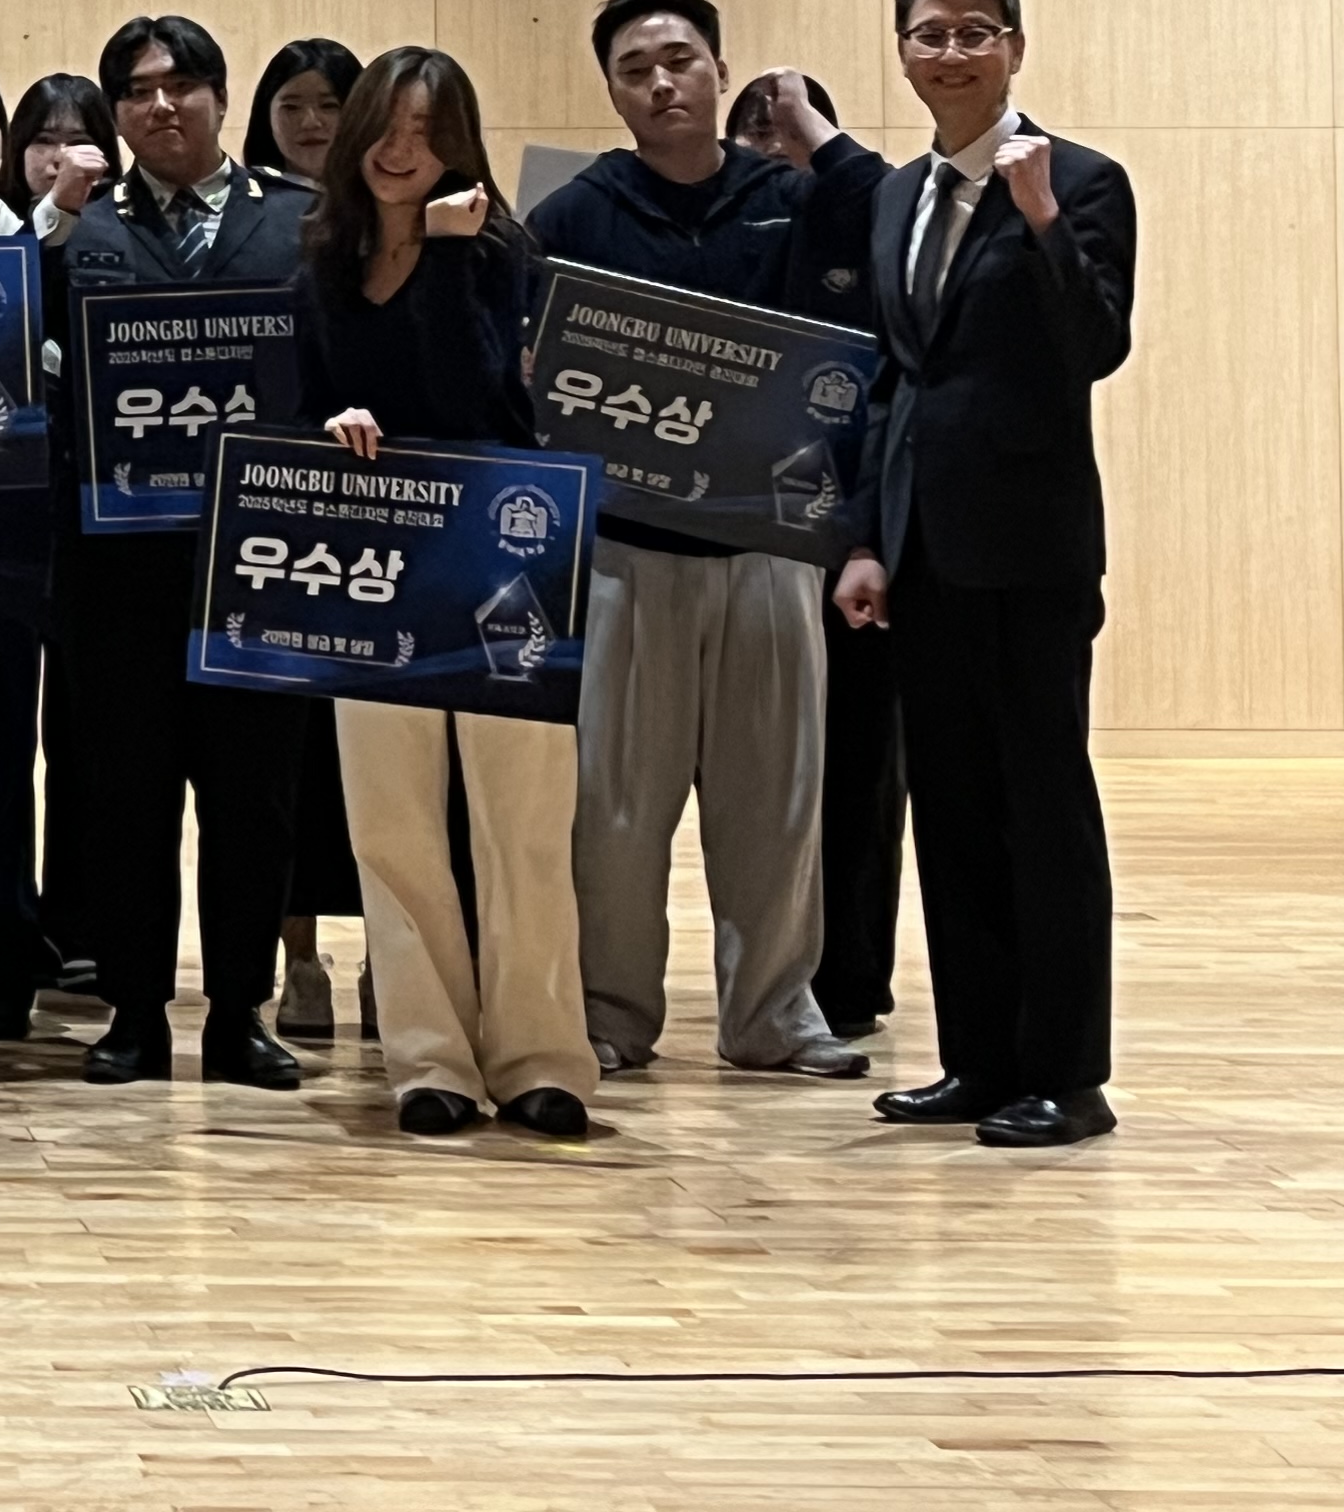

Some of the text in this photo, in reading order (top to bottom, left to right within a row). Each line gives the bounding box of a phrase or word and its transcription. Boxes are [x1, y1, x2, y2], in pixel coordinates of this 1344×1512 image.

[106, 314, 294, 343] JOONGBU UNIVERSI
[566, 303, 783, 371] JOONGBU UNIVERSITY
[547, 369, 713, 445] 우수상
[240, 463, 464, 506] JOONGBU UNIVERSITY
[235, 536, 405, 603] 우수상
